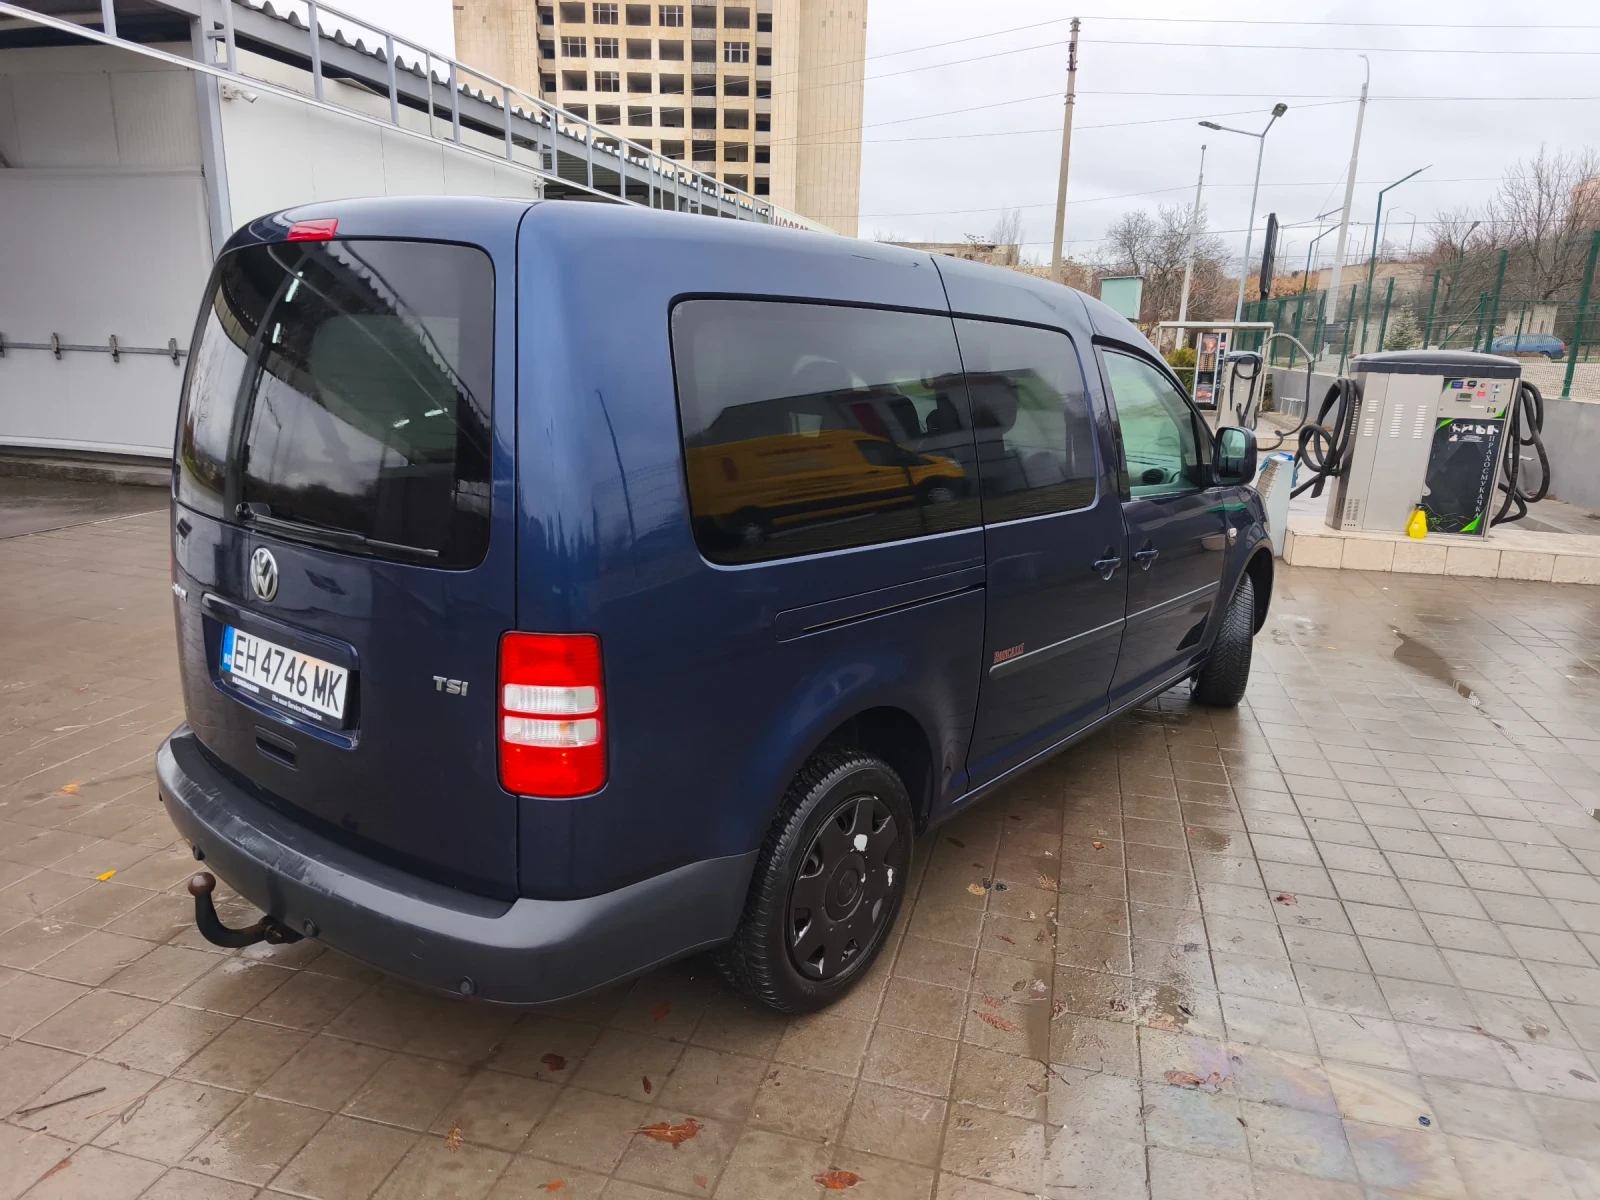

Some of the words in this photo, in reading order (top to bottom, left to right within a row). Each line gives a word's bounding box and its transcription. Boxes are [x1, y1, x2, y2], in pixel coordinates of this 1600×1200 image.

[1474, 436, 1496, 518] ПРАХОСМУКАЧКА
[223, 653, 232, 665] BG
[233, 634, 259, 677] EH
[260, 647, 308, 697] 4746
[312, 665, 343, 712] MK
[432, 675, 469, 697] TSI
